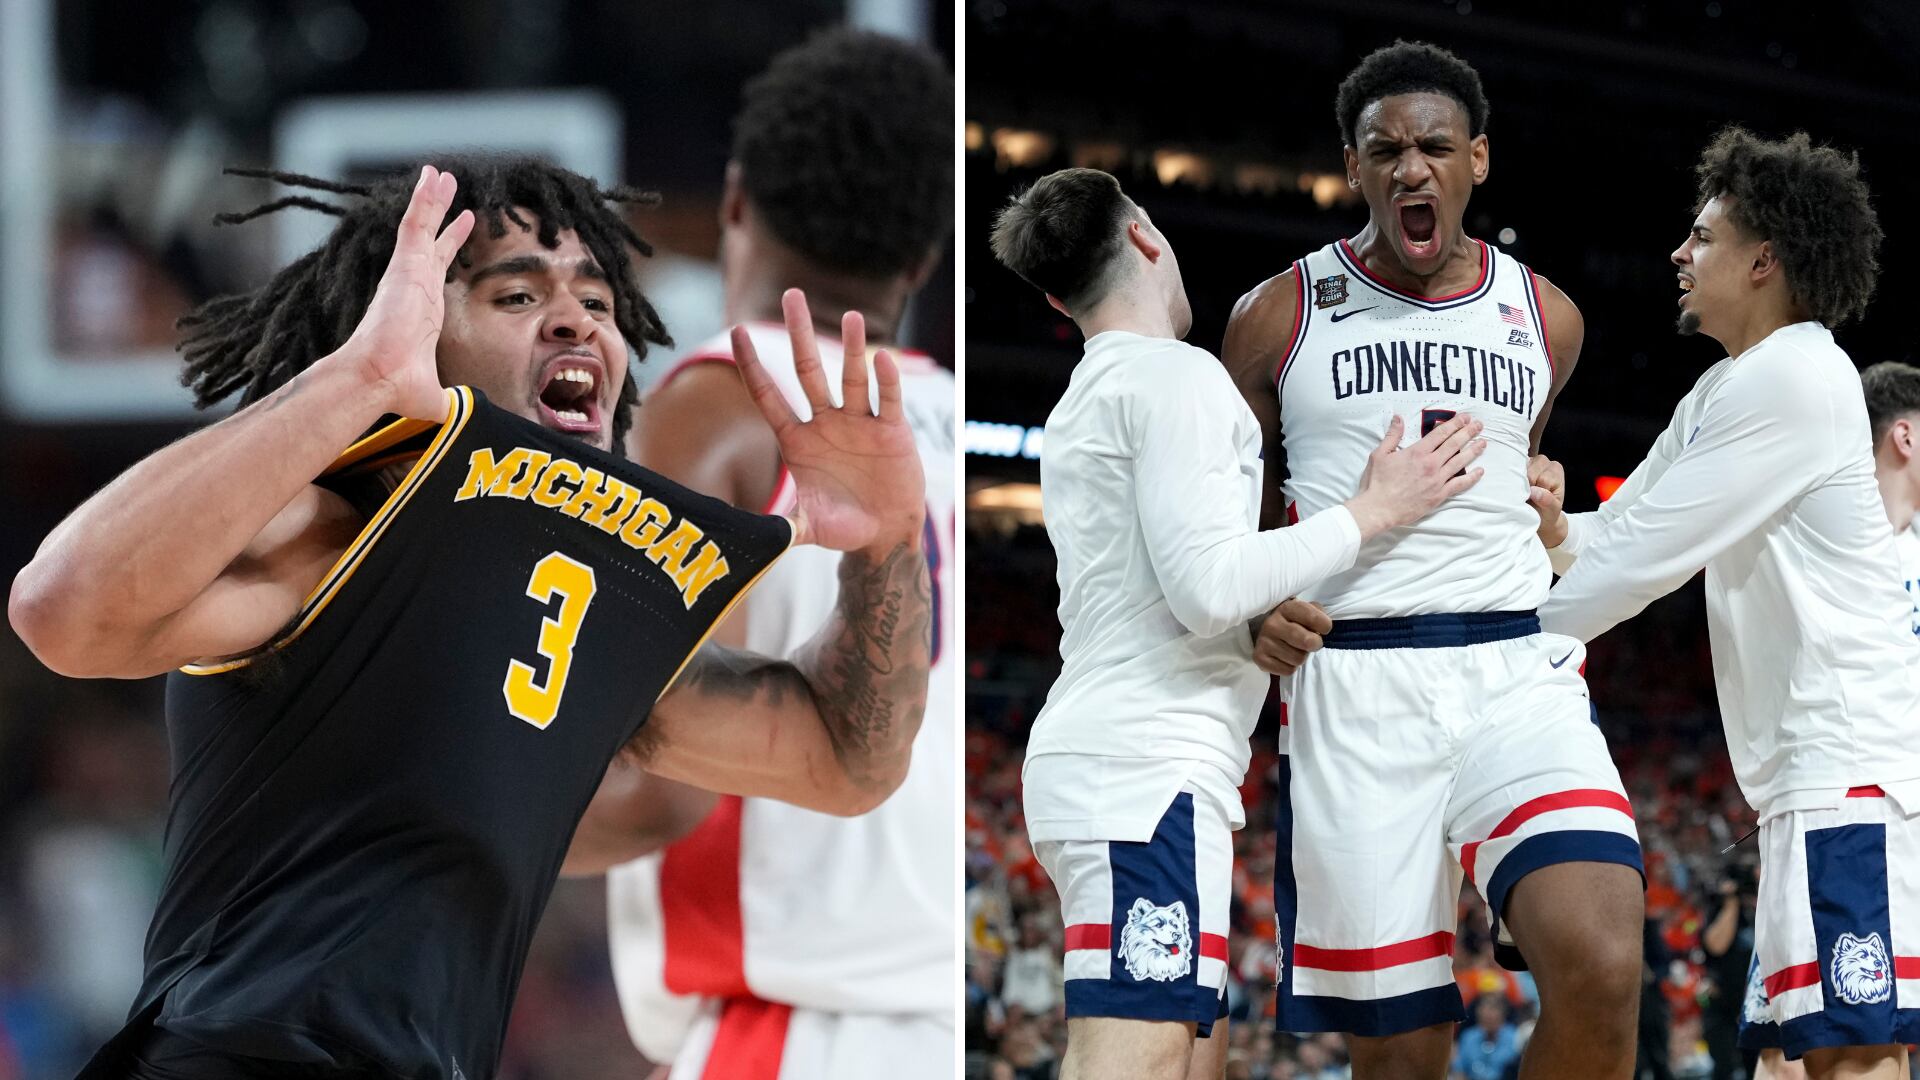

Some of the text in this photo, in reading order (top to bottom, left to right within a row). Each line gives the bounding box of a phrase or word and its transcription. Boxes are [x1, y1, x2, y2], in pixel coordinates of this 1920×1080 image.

[1319, 280, 1343, 290] FINAL
[1320, 292, 1342, 303] FOUR
[1508, 336, 1534, 348] EAST
[1510, 329, 1530, 339] BIG
[1331, 340, 1536, 421] CONNECTICUT
[454, 446, 731, 612] MICHIGAN
[502, 550, 597, 731] 3
[859, 586, 903, 676] Chaser
